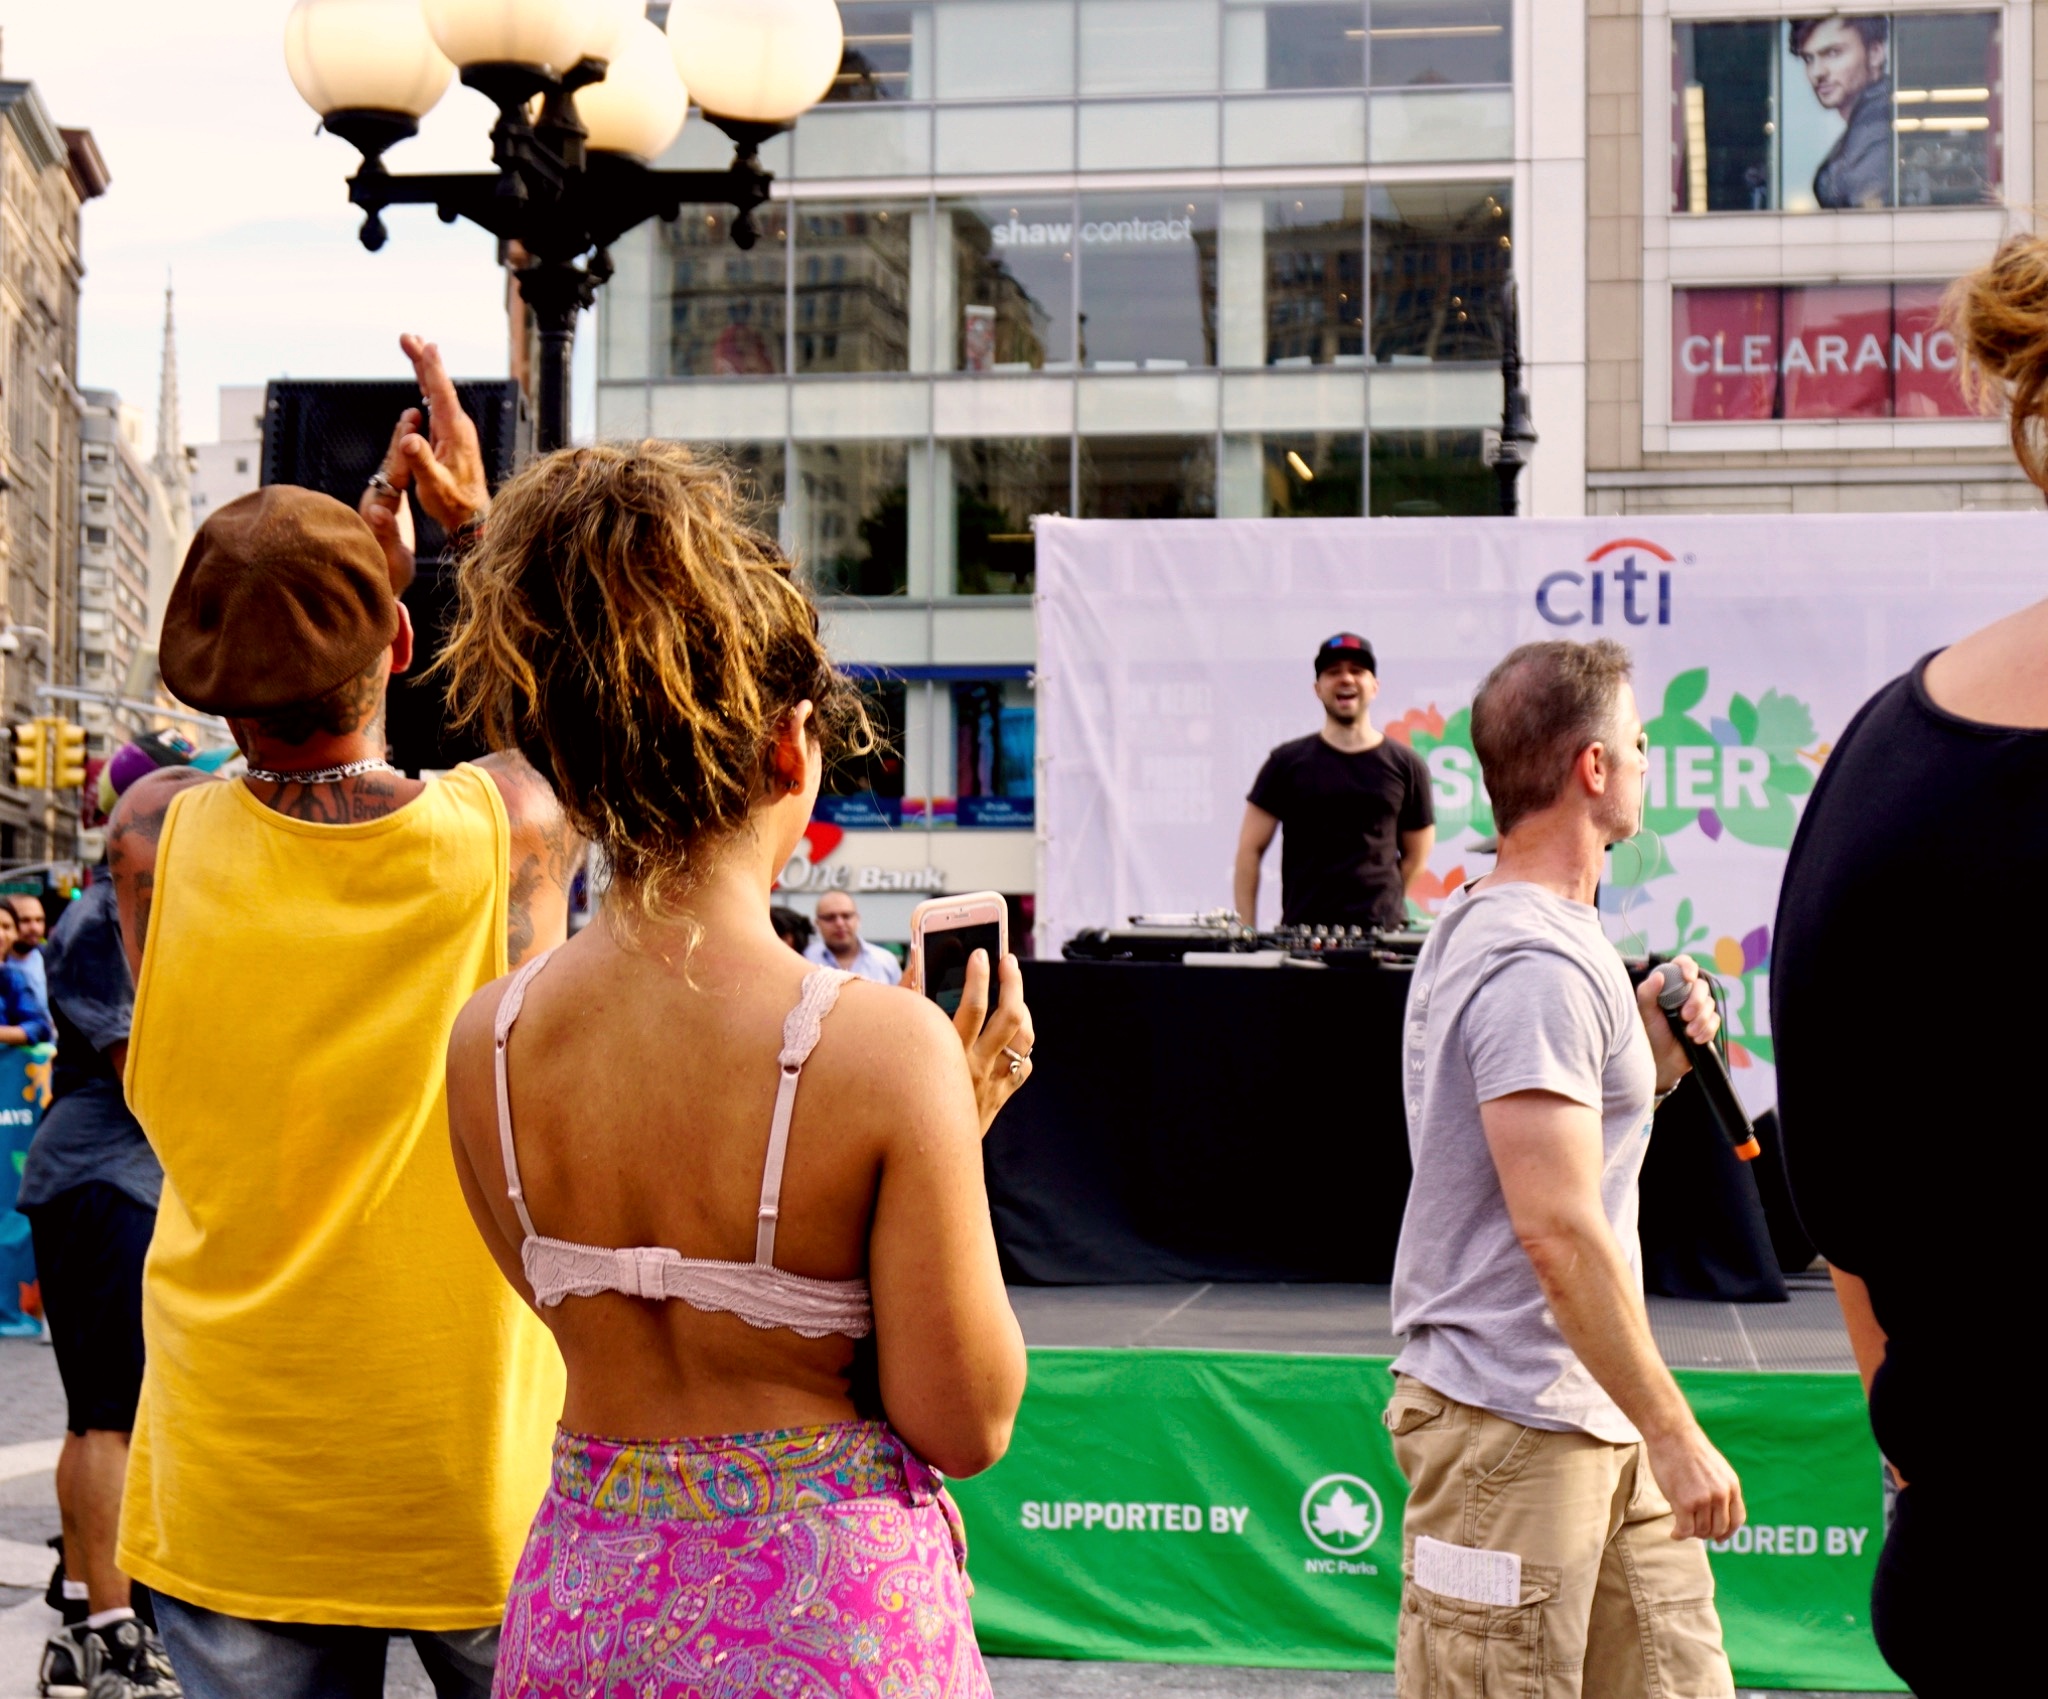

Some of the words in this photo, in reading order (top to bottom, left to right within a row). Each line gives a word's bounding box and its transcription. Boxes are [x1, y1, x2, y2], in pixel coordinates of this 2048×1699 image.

[992, 218, 1073, 245] shaw
[1081, 215, 1193, 242] contract
[1681, 331, 1960, 375] CLEARANC
[1536, 553, 1671, 626] citi
[778, 855, 850, 889] One
[859, 865, 946, 889] Bank
[0, 1108, 33, 1126] AYS
[1021, 1501, 1203, 1532] SUPPORTED
[1209, 1506, 1249, 1534] BY
[1709, 1525, 1818, 1555] ORED
[1825, 1526, 1869, 1556] BY
[1305, 1559, 1336, 1574] NYC
[1338, 1560, 1379, 1576] Parks
